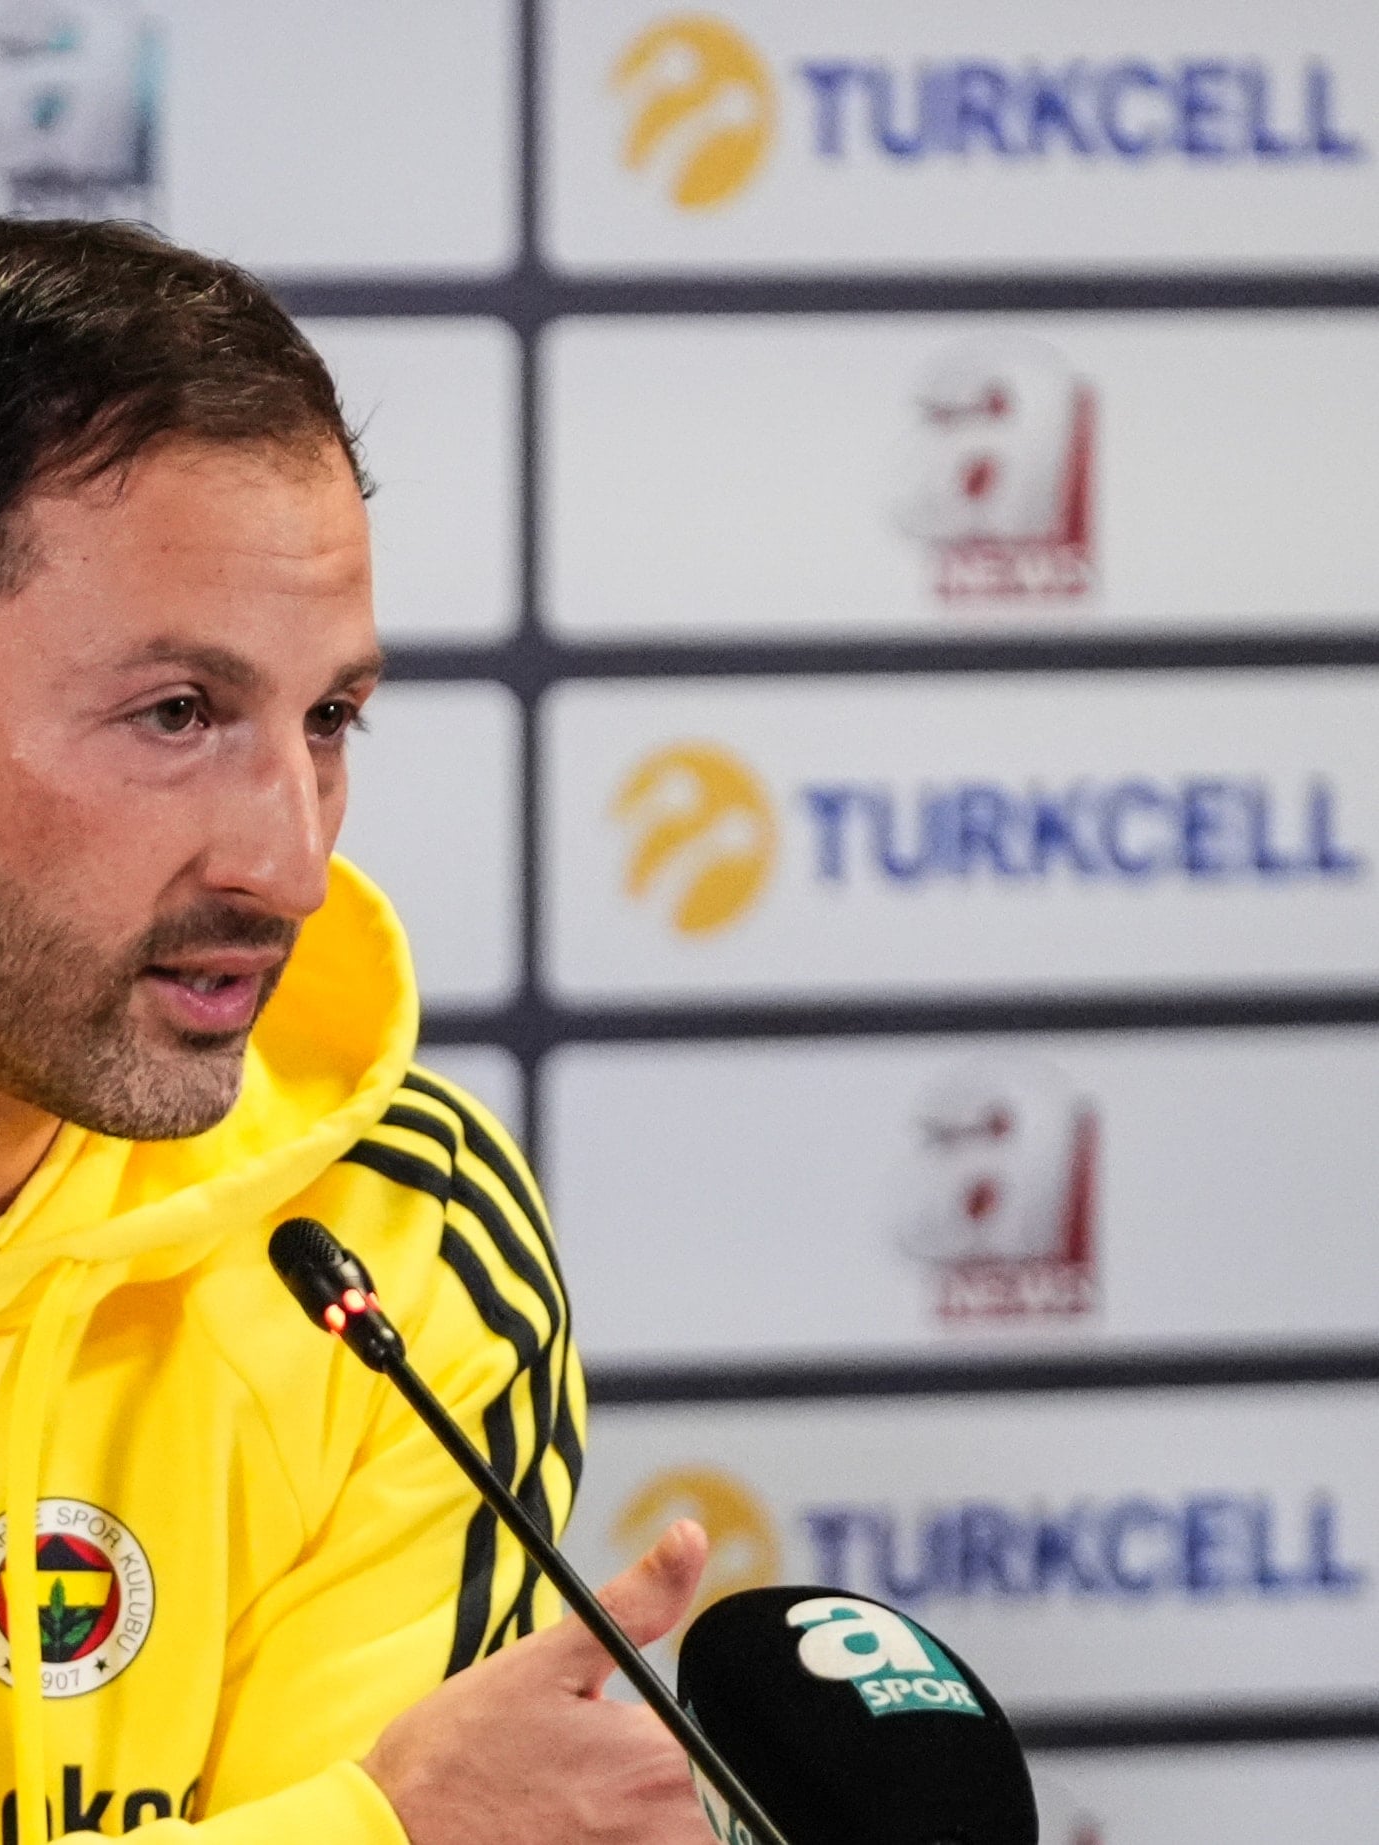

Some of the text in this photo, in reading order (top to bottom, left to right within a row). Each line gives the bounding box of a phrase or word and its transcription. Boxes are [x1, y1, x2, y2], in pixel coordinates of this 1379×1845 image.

[800, 60, 1360, 161] TURKCELL
[800, 778, 1360, 882] TURKCELL
[56, 1506, 122, 1549] SPOR
[800, 1496, 1360, 1604] TURKCELL
[860, 1676, 978, 1709] SPOR
